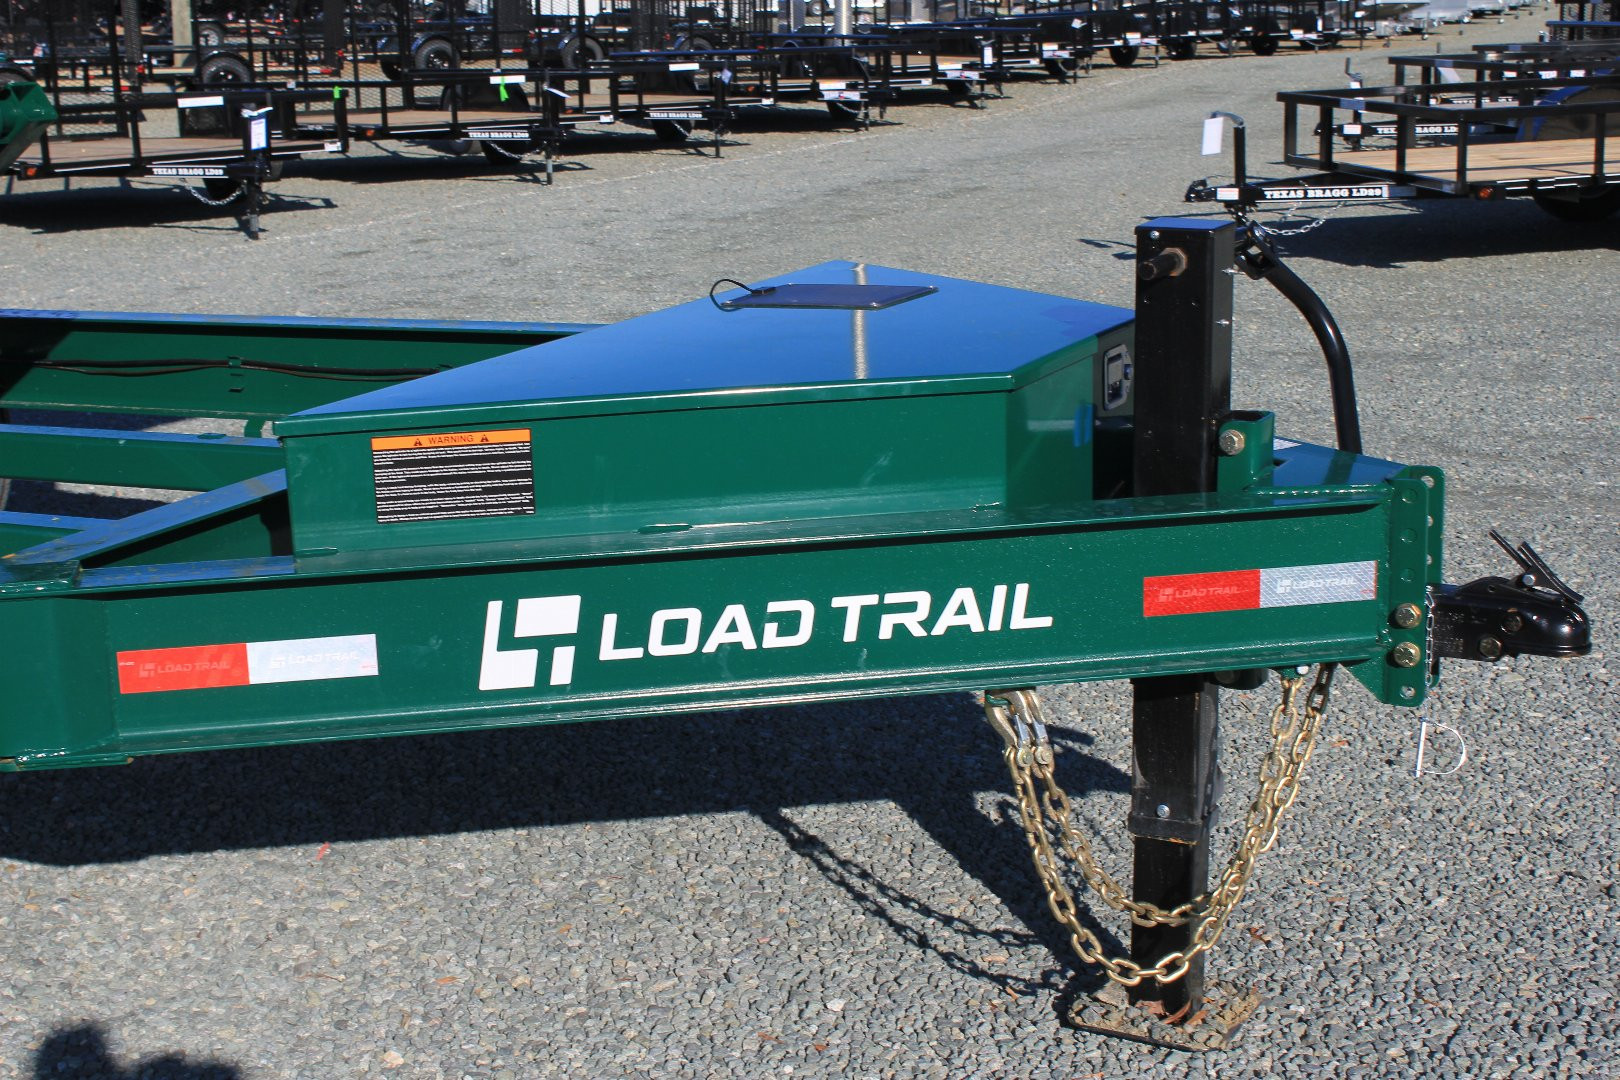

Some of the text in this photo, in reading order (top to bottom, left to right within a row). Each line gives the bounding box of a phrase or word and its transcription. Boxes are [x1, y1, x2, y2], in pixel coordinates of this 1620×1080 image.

[177, 168, 204, 176] BRAGG
[1263, 188, 1382, 199] TEXAS BRAGG LD29
[428, 434, 474, 445] WARNING
[1293, 576, 1357, 589] LOAD TRAIL
[1175, 585, 1241, 599] LOAD TRAIL
[599, 582, 1054, 661] LOAD TRAIL
[288, 651, 360, 666] LOAD TRAIL
[157, 660, 231, 674] LOAD TRAIL
